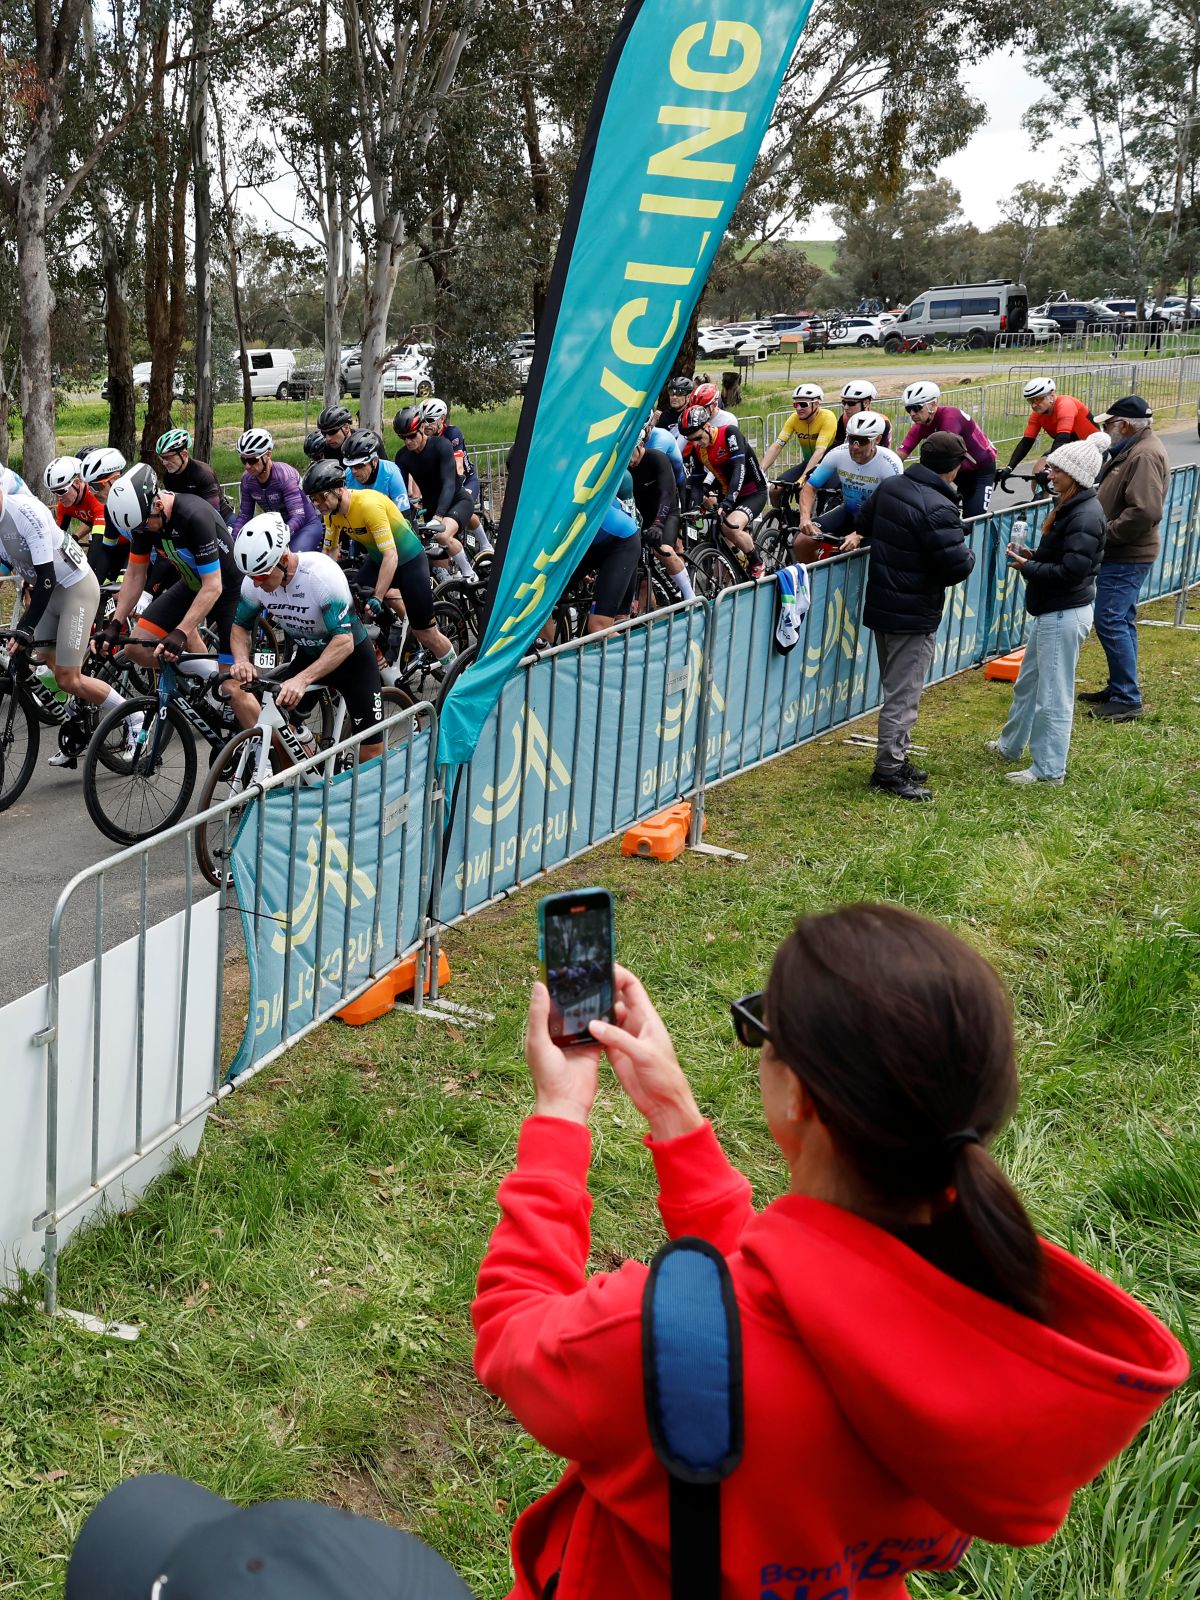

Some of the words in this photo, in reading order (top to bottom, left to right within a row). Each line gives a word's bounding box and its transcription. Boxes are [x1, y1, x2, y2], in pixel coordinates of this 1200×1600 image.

[266, 603, 310, 614] GIANT
[73, 606, 86, 650] COLLECTIVE
[259, 653, 275, 666] 615
[26, 675, 72, 725] FACTOR
[372, 691, 382, 721] efex
